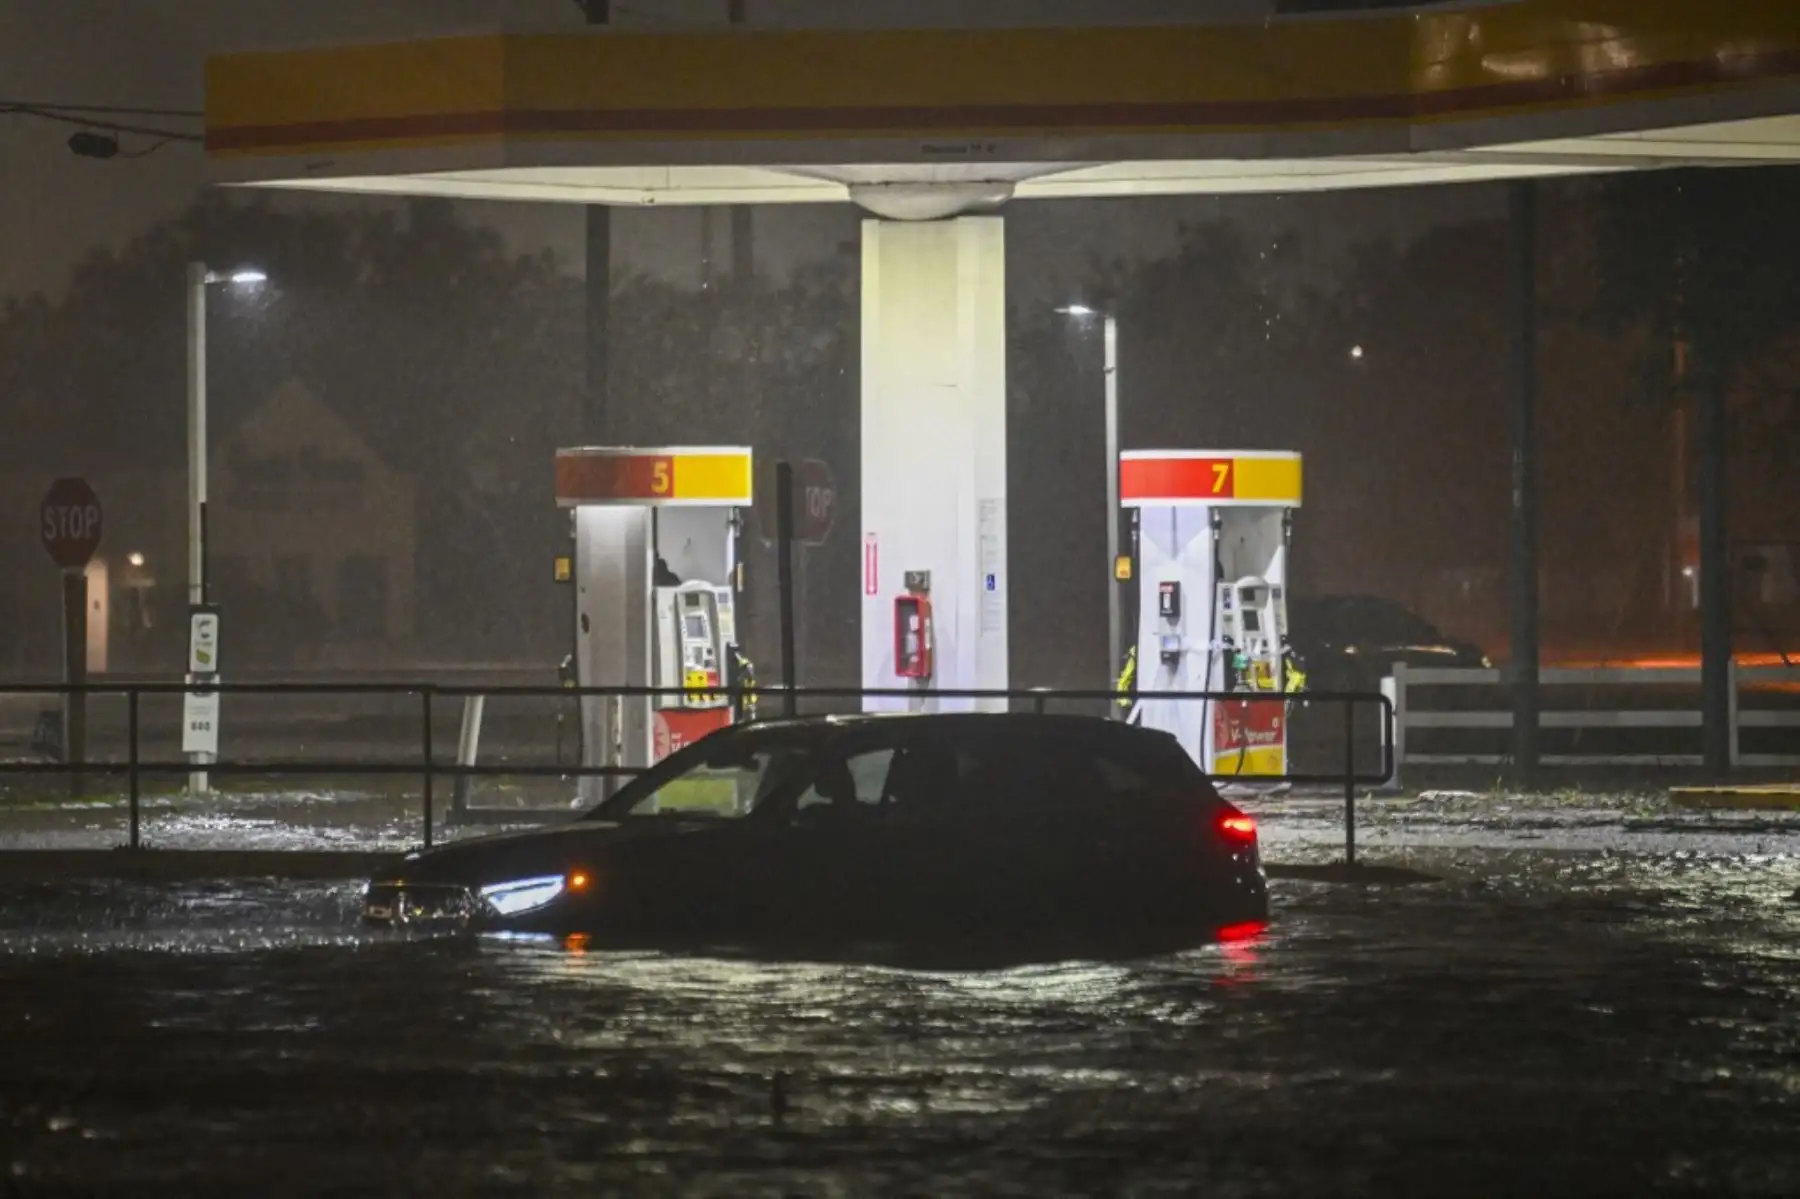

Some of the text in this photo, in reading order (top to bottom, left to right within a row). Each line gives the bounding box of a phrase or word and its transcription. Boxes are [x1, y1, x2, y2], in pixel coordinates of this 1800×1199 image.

[651, 461, 669, 493] 5
[1211, 464, 1230, 492] 7
[805, 486, 832, 519] TOP
[44, 505, 99, 540] STOP
